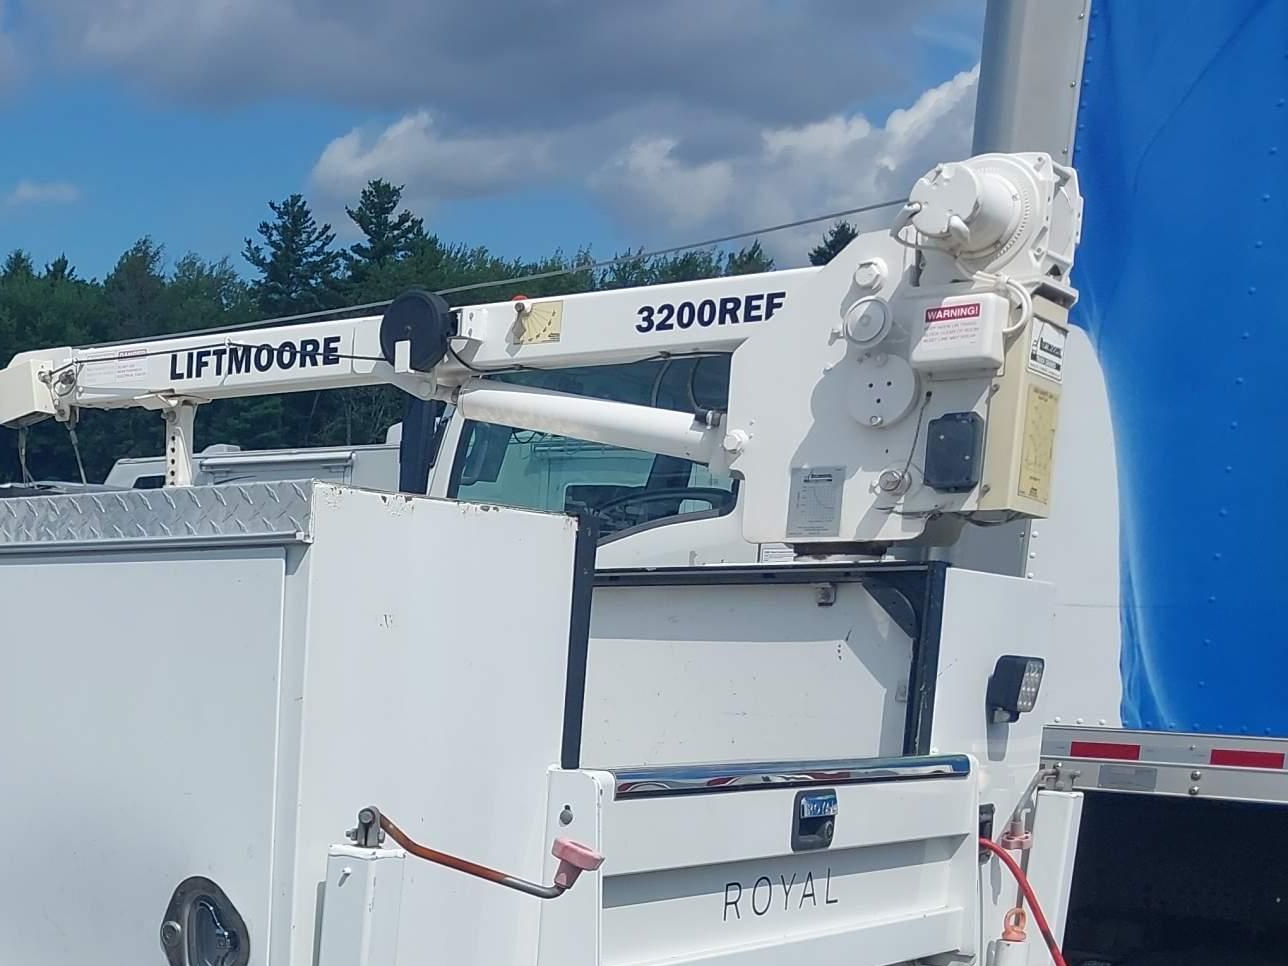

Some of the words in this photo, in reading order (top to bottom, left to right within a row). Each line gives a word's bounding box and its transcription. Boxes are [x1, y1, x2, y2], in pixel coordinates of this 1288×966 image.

[636, 291, 786, 333] 3200REF
[926, 304, 980, 321] WARNING!
[169, 335, 341, 381] LIFTMOORE
[722, 866, 840, 922] ROYAL
